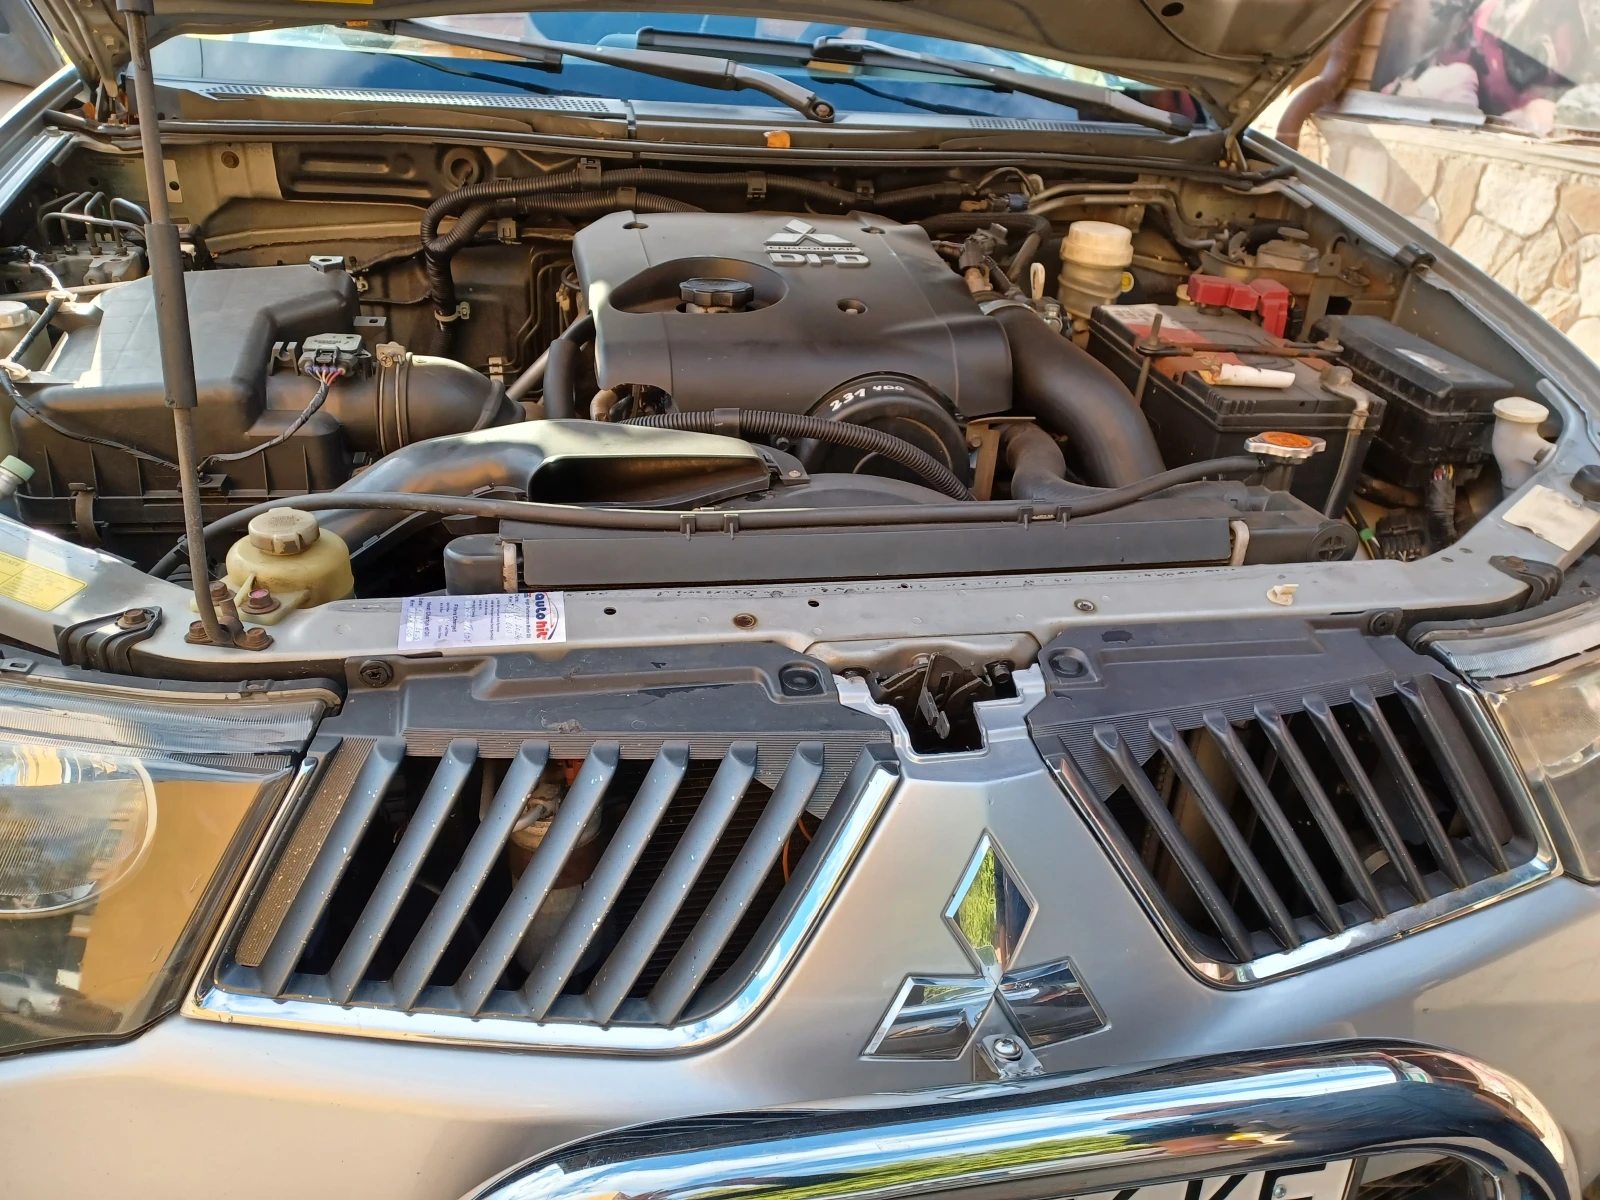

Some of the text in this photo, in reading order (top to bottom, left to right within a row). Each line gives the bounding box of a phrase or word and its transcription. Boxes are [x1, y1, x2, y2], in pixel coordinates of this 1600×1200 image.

[769, 252, 870, 267] DI-D
[830, 388, 866, 412] 231
[535, 593, 549, 638] auto hit
